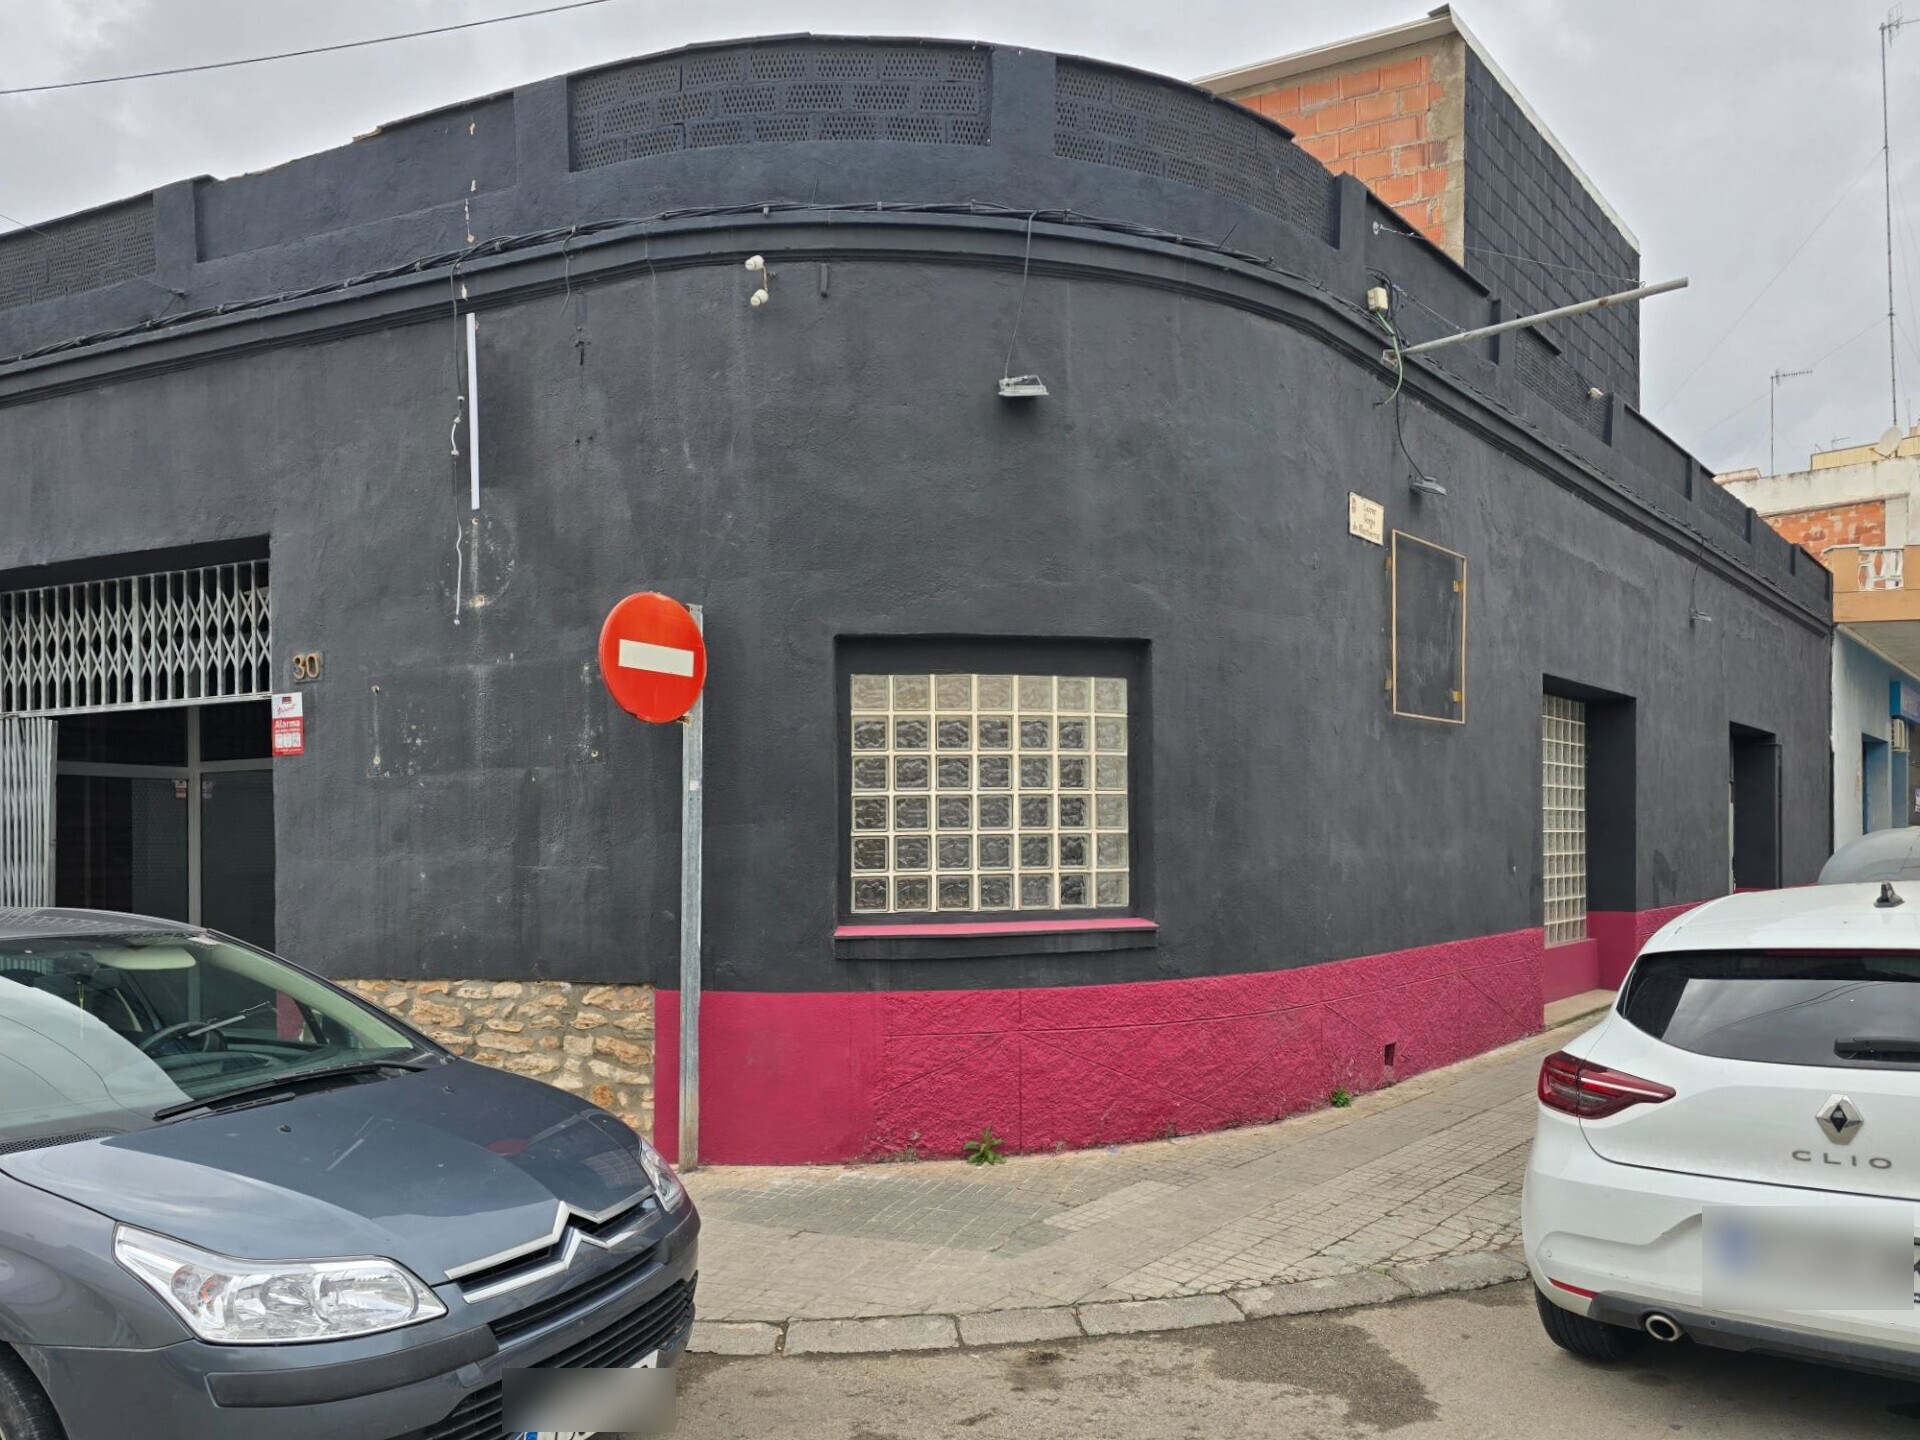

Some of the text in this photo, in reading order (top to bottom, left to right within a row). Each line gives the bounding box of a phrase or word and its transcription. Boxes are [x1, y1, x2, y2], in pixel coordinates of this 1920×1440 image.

[292, 653, 319, 680] 30
[274, 719, 301, 729] Alarma
[1792, 1150, 1892, 1169] CLIO
